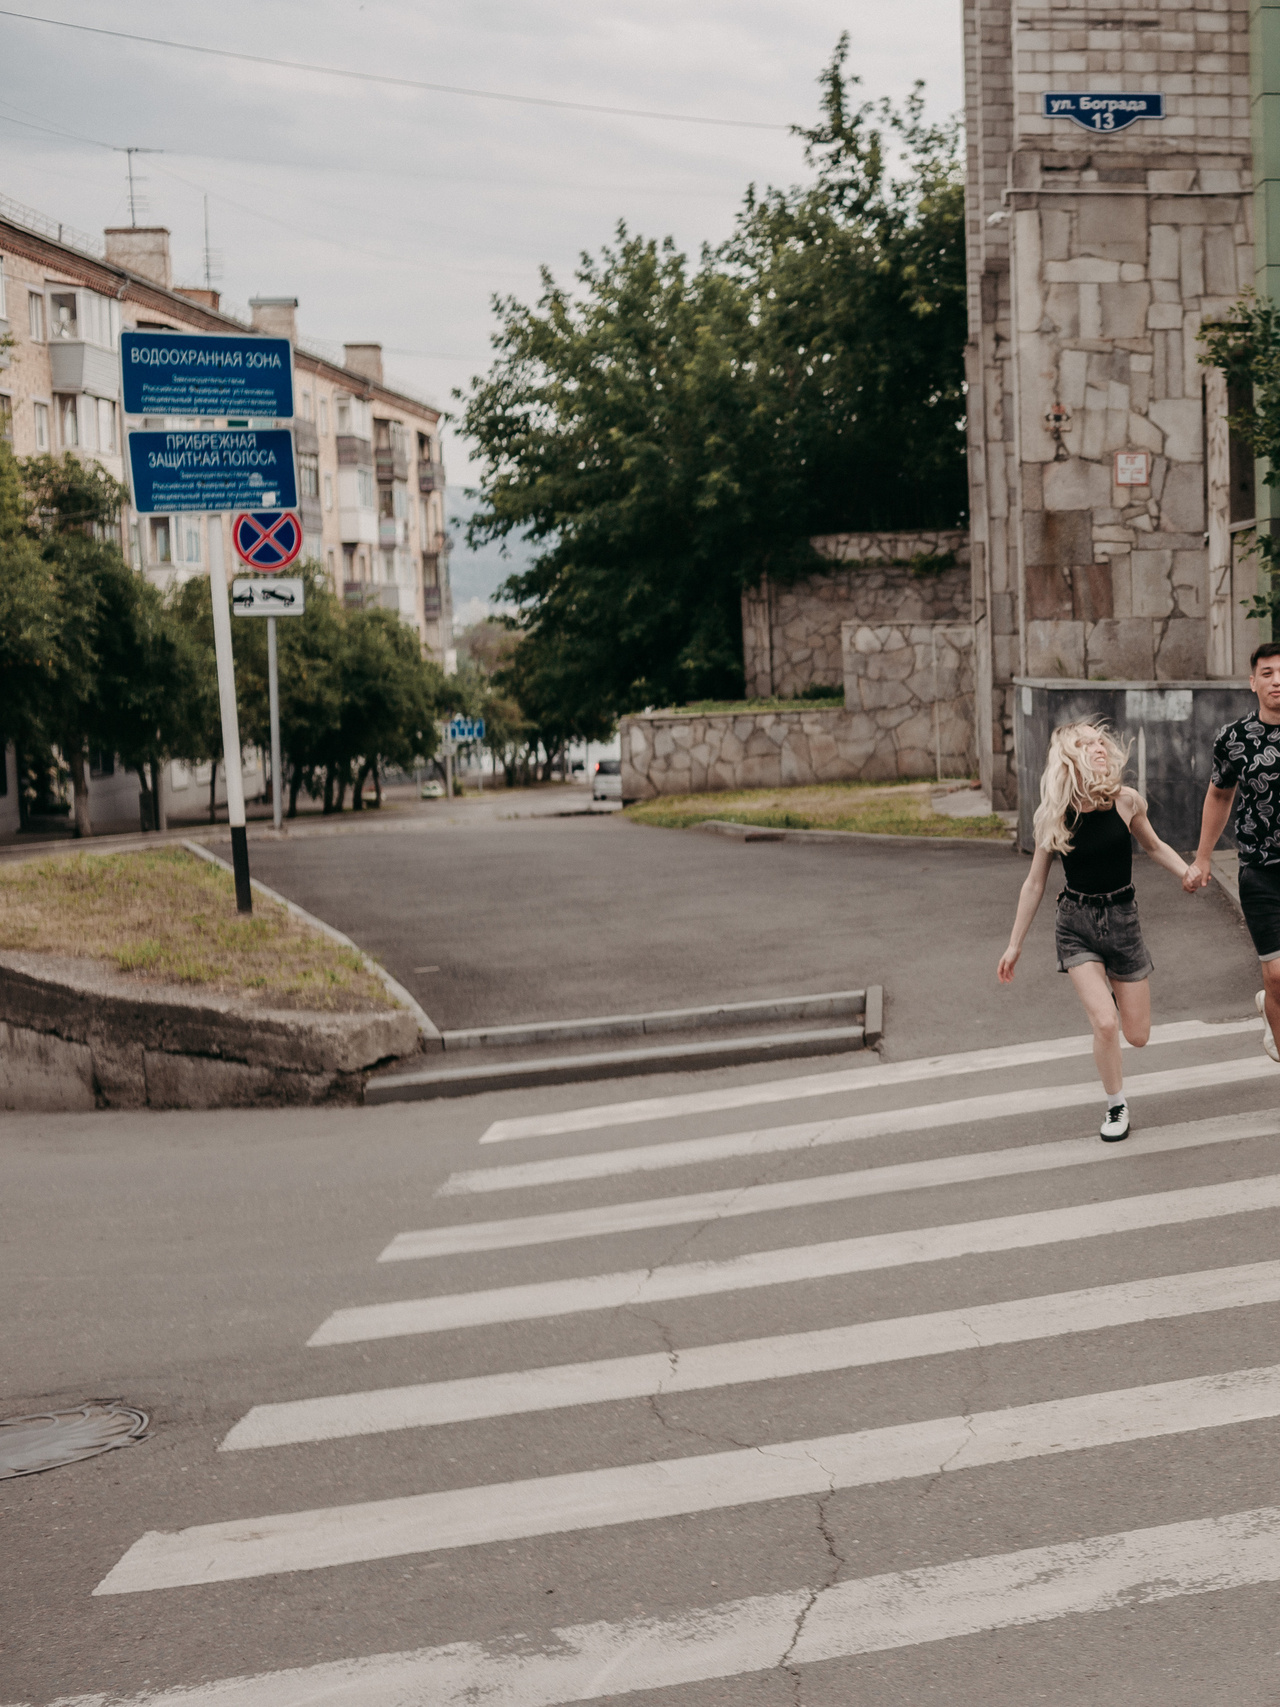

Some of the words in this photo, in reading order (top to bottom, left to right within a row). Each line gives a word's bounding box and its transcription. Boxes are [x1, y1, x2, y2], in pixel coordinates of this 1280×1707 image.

[1050, 99, 1076, 113] ул.
[1079, 96, 1148, 113] Бограда
[1091, 112, 1115, 129] 13
[130, 347, 242, 368] ВОДООХРАННАЯ
[245, 351, 282, 369] ЗОНА
[166, 433, 257, 450] ПРИБРЕЖНАЯ
[148, 450, 220, 470] ЗАЩИТНАЯ
[223, 449, 277, 467] ПОЛОСА
